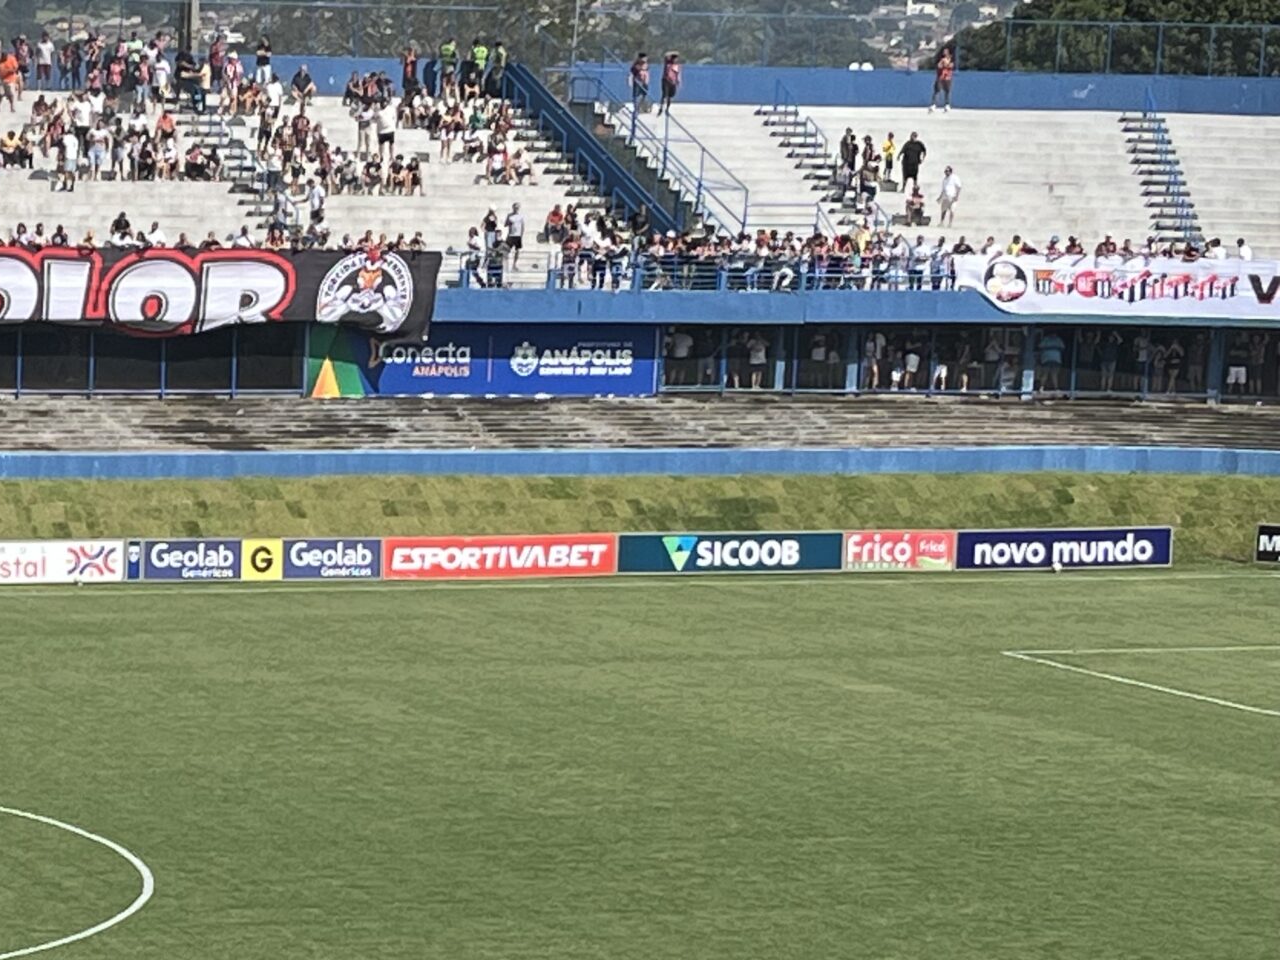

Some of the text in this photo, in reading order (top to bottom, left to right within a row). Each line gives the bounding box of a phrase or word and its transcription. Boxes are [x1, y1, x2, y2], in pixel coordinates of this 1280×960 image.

[380, 342, 470, 364] Conecta
[540, 346, 633, 366] ANÁPOLIS
[151, 543, 234, 568] Geolab
[251, 546, 273, 573] G
[290, 541, 372, 567] Geolab
[391, 543, 608, 571] ESPORTIVABET
[696, 539, 801, 567] SICOOB
[847, 534, 912, 562] Fricó
[974, 533, 1153, 565] novo mundo
